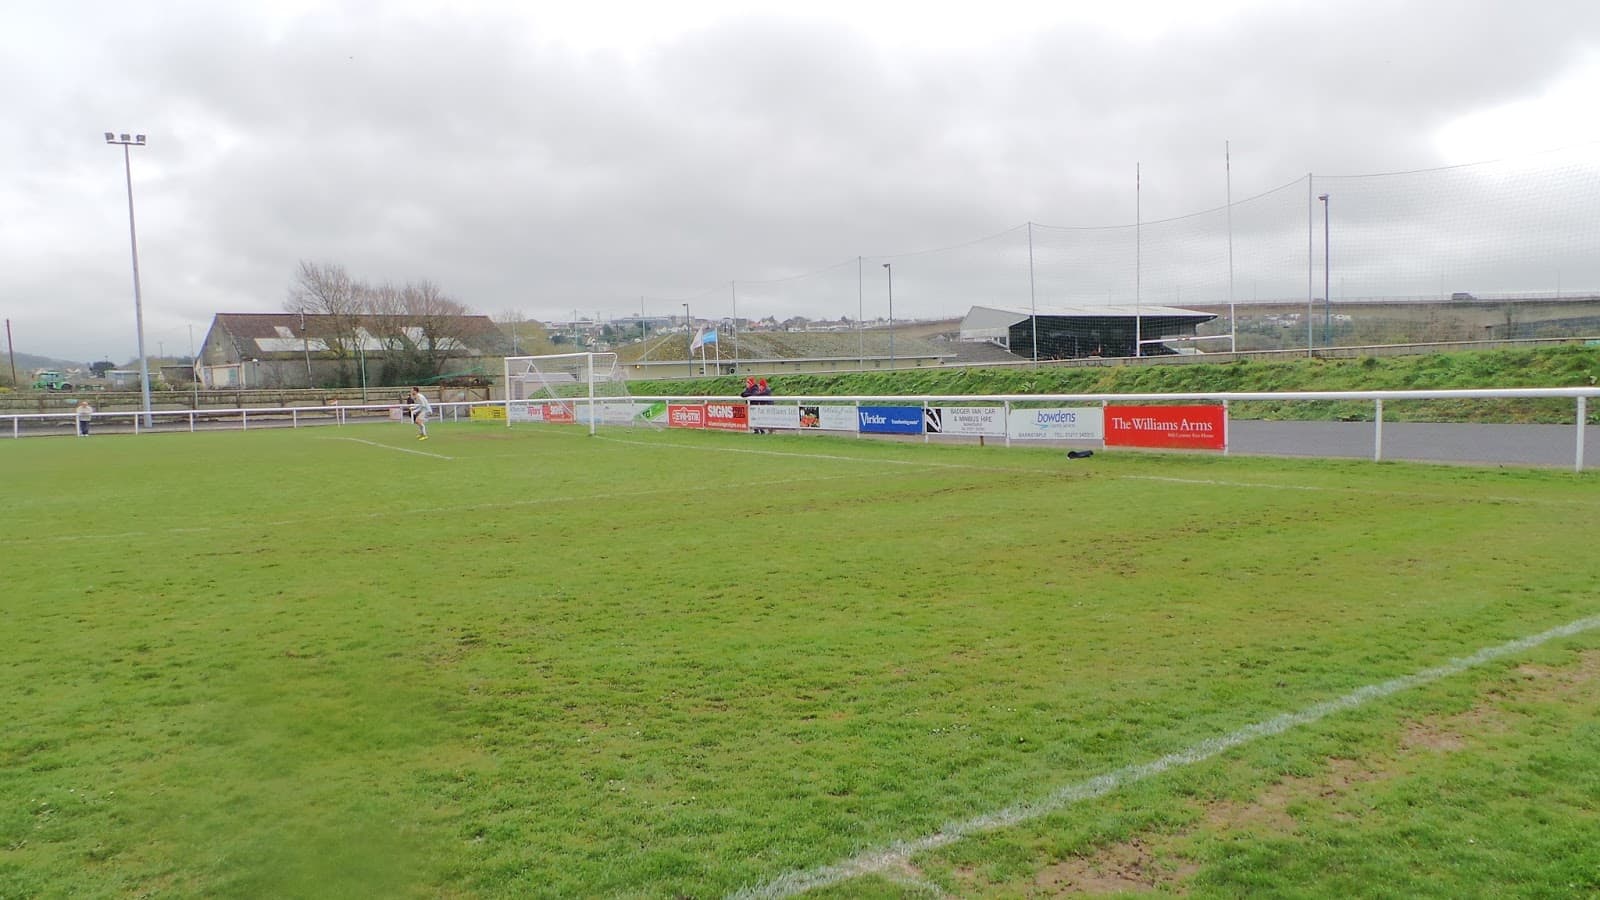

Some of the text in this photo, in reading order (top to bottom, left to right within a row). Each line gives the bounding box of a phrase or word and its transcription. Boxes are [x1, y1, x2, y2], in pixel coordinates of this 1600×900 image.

[707, 405, 733, 418] SIGNS
[1037, 410, 1076, 423] bowdens
[860, 412, 887, 426] Viridor
[1111, 417, 1213, 431] The Williams Arms
